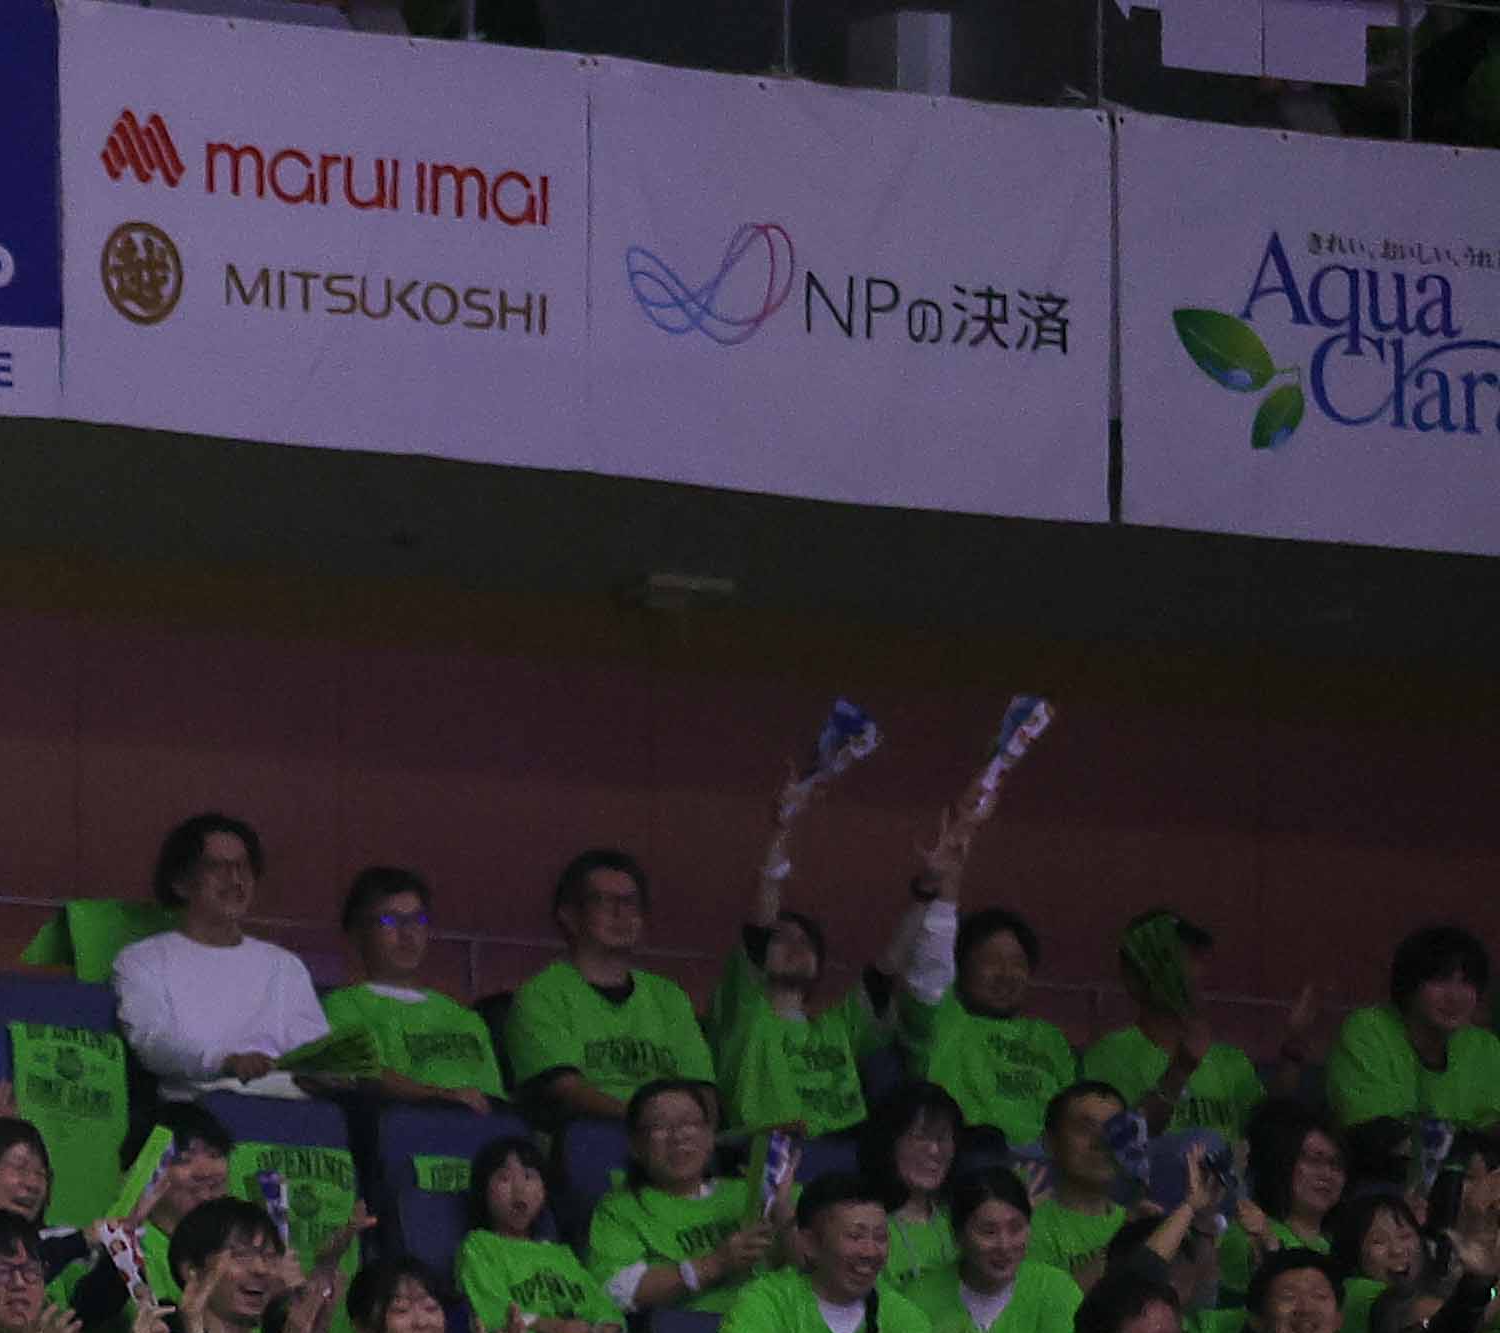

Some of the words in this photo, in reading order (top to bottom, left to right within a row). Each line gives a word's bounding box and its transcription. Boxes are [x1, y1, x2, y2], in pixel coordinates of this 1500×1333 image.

[225, 263, 549, 336] MITSUKOSHI
[804, 270, 1071, 354] NPの決済
[1239, 231, 1462, 355] Aqua
[1310, 333, 1500, 438] Clar
